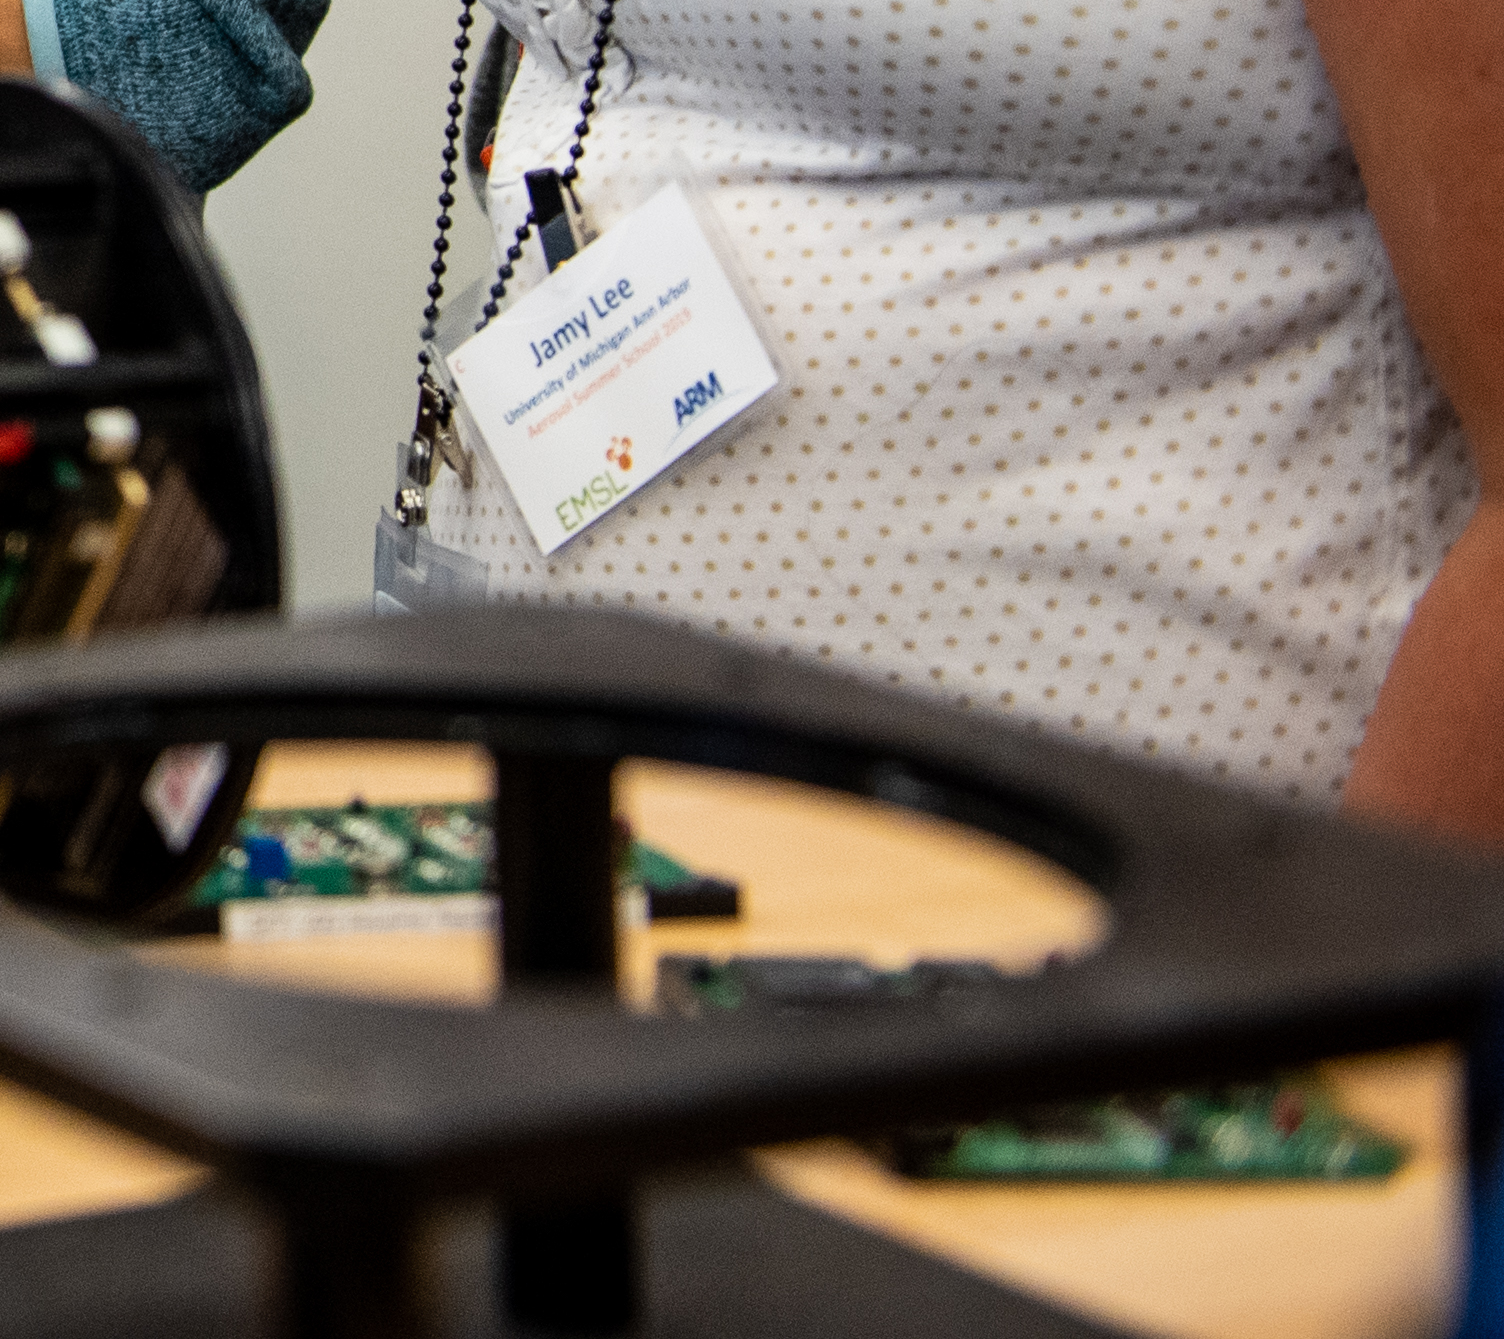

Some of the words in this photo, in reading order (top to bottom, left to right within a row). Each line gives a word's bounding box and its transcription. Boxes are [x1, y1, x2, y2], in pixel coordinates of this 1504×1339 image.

[503, 376, 565, 426] University
[566, 362, 580, 381] of
[578, 324, 633, 371] Michigan
[632, 304, 657, 329] Ann
[657, 277, 691, 308] Arbor
[530, 311, 591, 368] Jamy
[589, 277, 635, 319] Lee
[528, 398, 574, 439] Aerosol
[574, 363, 621, 406] Summer
[622, 332, 662, 368] School
[673, 370, 724, 426] ARM
[555, 469, 629, 533] EMSL
